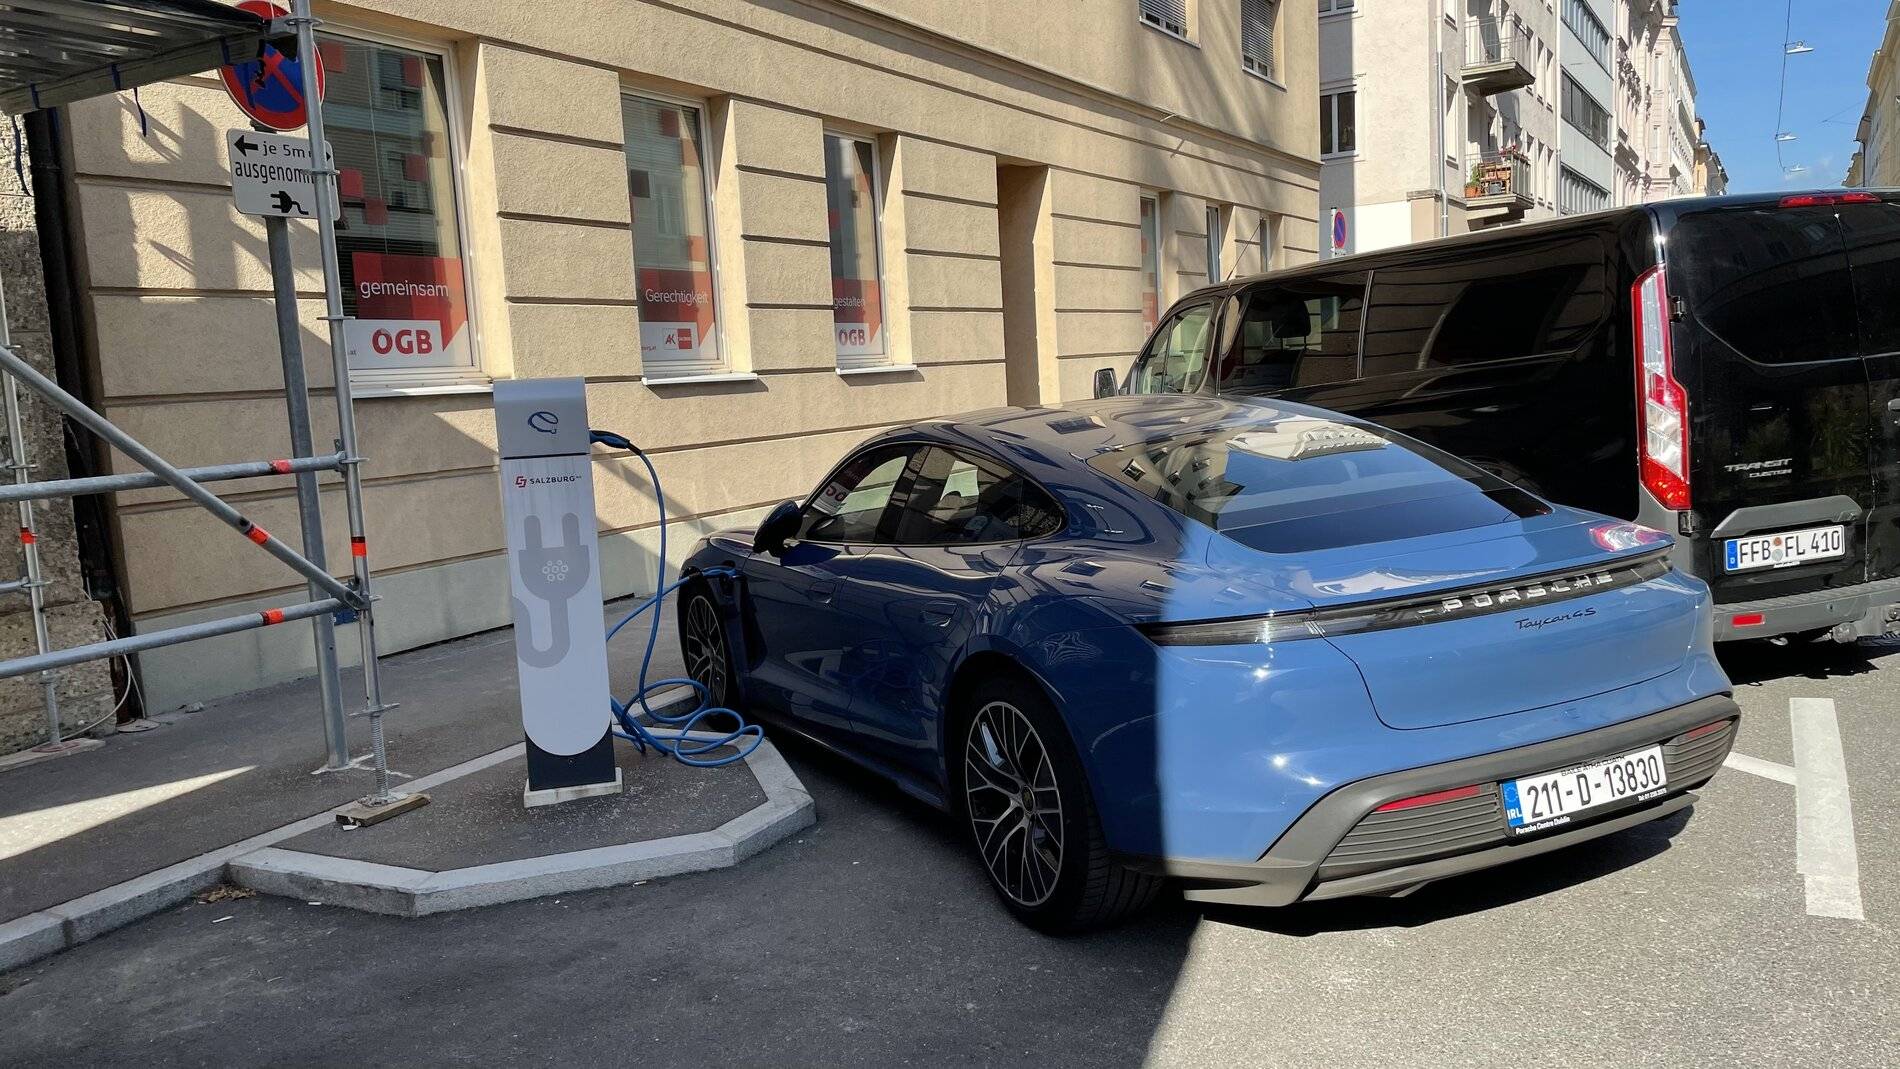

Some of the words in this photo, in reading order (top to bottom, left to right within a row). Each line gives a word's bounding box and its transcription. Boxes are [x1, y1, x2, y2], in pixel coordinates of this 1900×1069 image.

[263, 141, 277, 156] je
[283, 144, 306, 158] 5m
[235, 161, 335, 186] ausgenom
[360, 280, 449, 299] gemeinsam
[645, 288, 709, 306] Gerechtigkeit
[1724, 458, 1793, 472] TRANSIT
[530, 475, 576, 485] SALZBURG
[1739, 539, 1771, 564] FFB
[1785, 535, 1806, 558] FL
[1811, 530, 1840, 554] 410
[1441, 571, 1614, 615] PORSCHE
[1526, 754, 1661, 819] 211-D-13830
[1507, 807, 1523, 820] IRL
